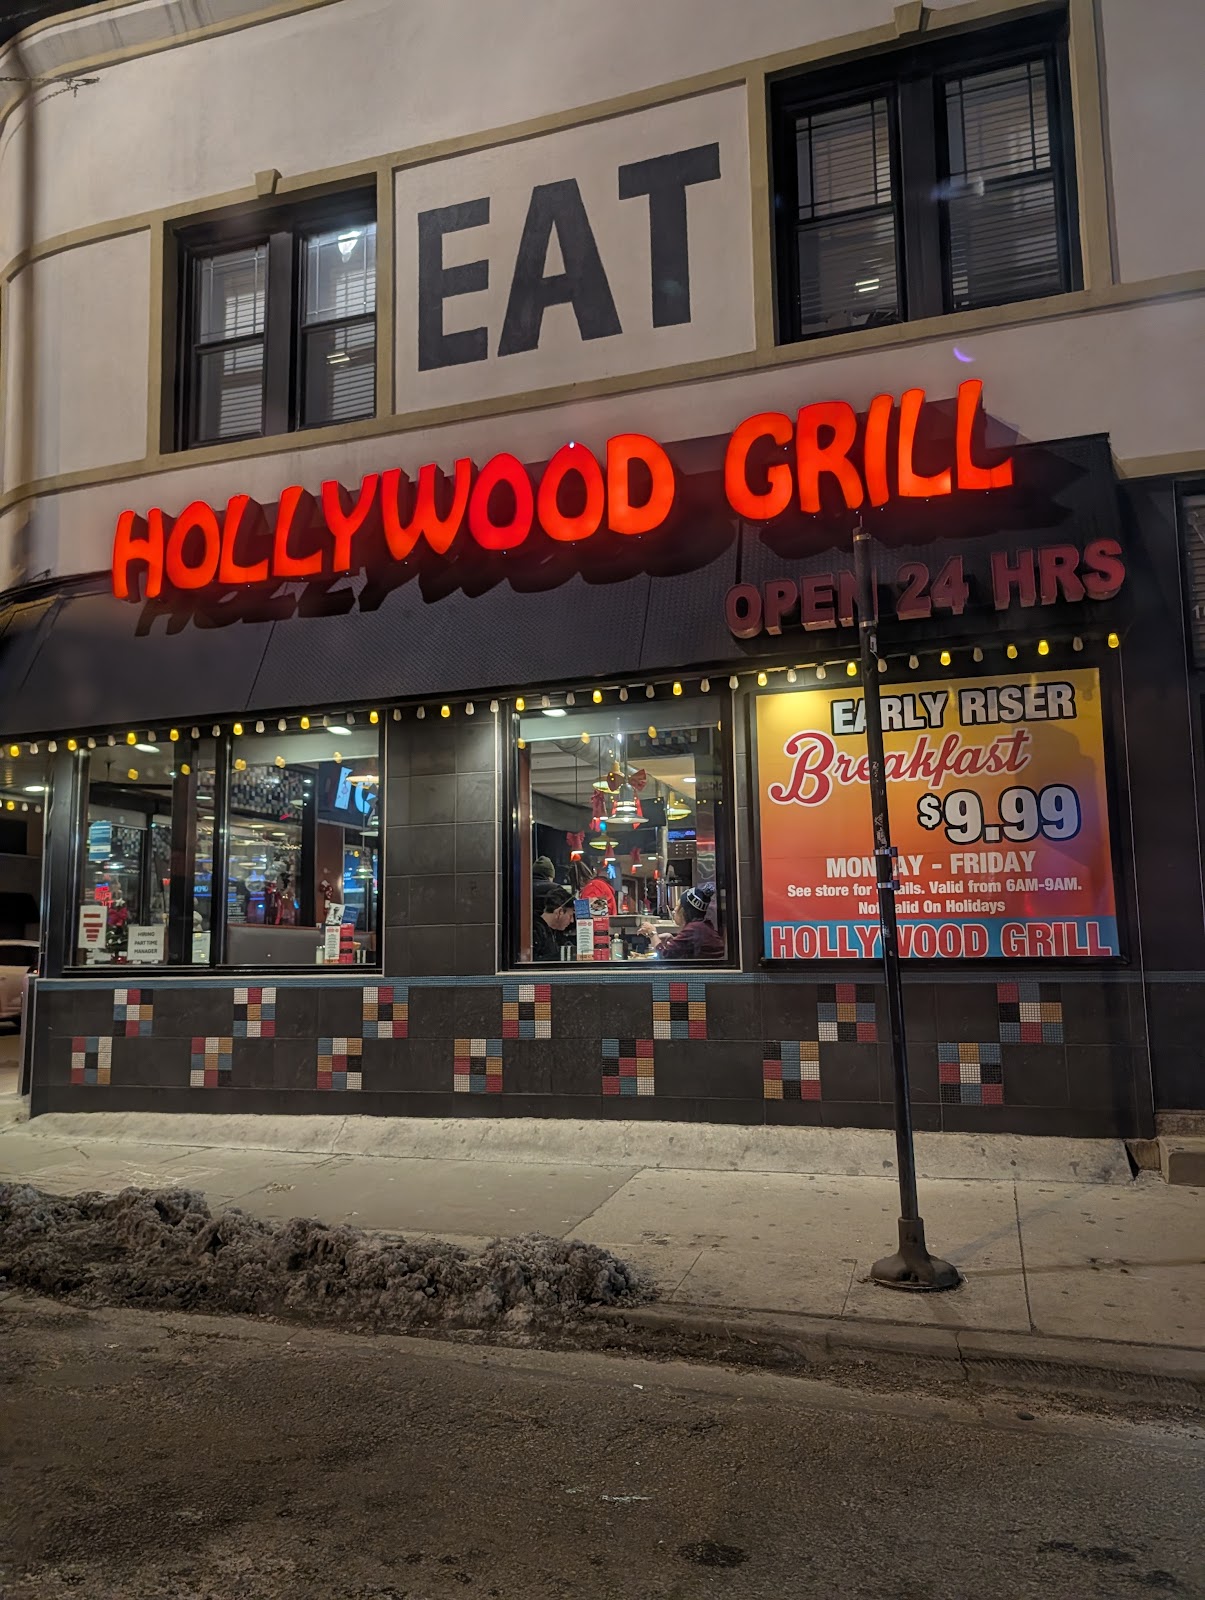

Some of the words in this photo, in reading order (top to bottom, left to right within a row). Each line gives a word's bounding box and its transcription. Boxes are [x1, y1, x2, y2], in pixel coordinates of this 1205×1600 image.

[418, 142, 721, 372] EAT
[112, 433, 675, 599] HOLLYWOOD
[725, 379, 1013, 520] GRILL
[896, 555, 970, 620] 24
[991, 538, 1126, 611] HRS
[958, 682, 1077, 726] RISER
[917, 784, 1082, 844] $9.99
[826, 855, 924, 878] MONAY
[950, 851, 1036, 874] FRIDAY
[787, 884, 812, 897] See
[815, 884, 849, 896] store
[852, 883, 873, 896] for
[876, 881, 926, 895] ails.
[929, 880, 964, 894] Valid
[968, 879, 1002, 893] from
[1006, 877, 1083, 892] 6AM-9AM.
[893, 900, 919, 914] alid
[923, 900, 942, 913] On
[946, 899, 1006, 915] Holidays
[1001, 921, 1112, 957] GRILL
